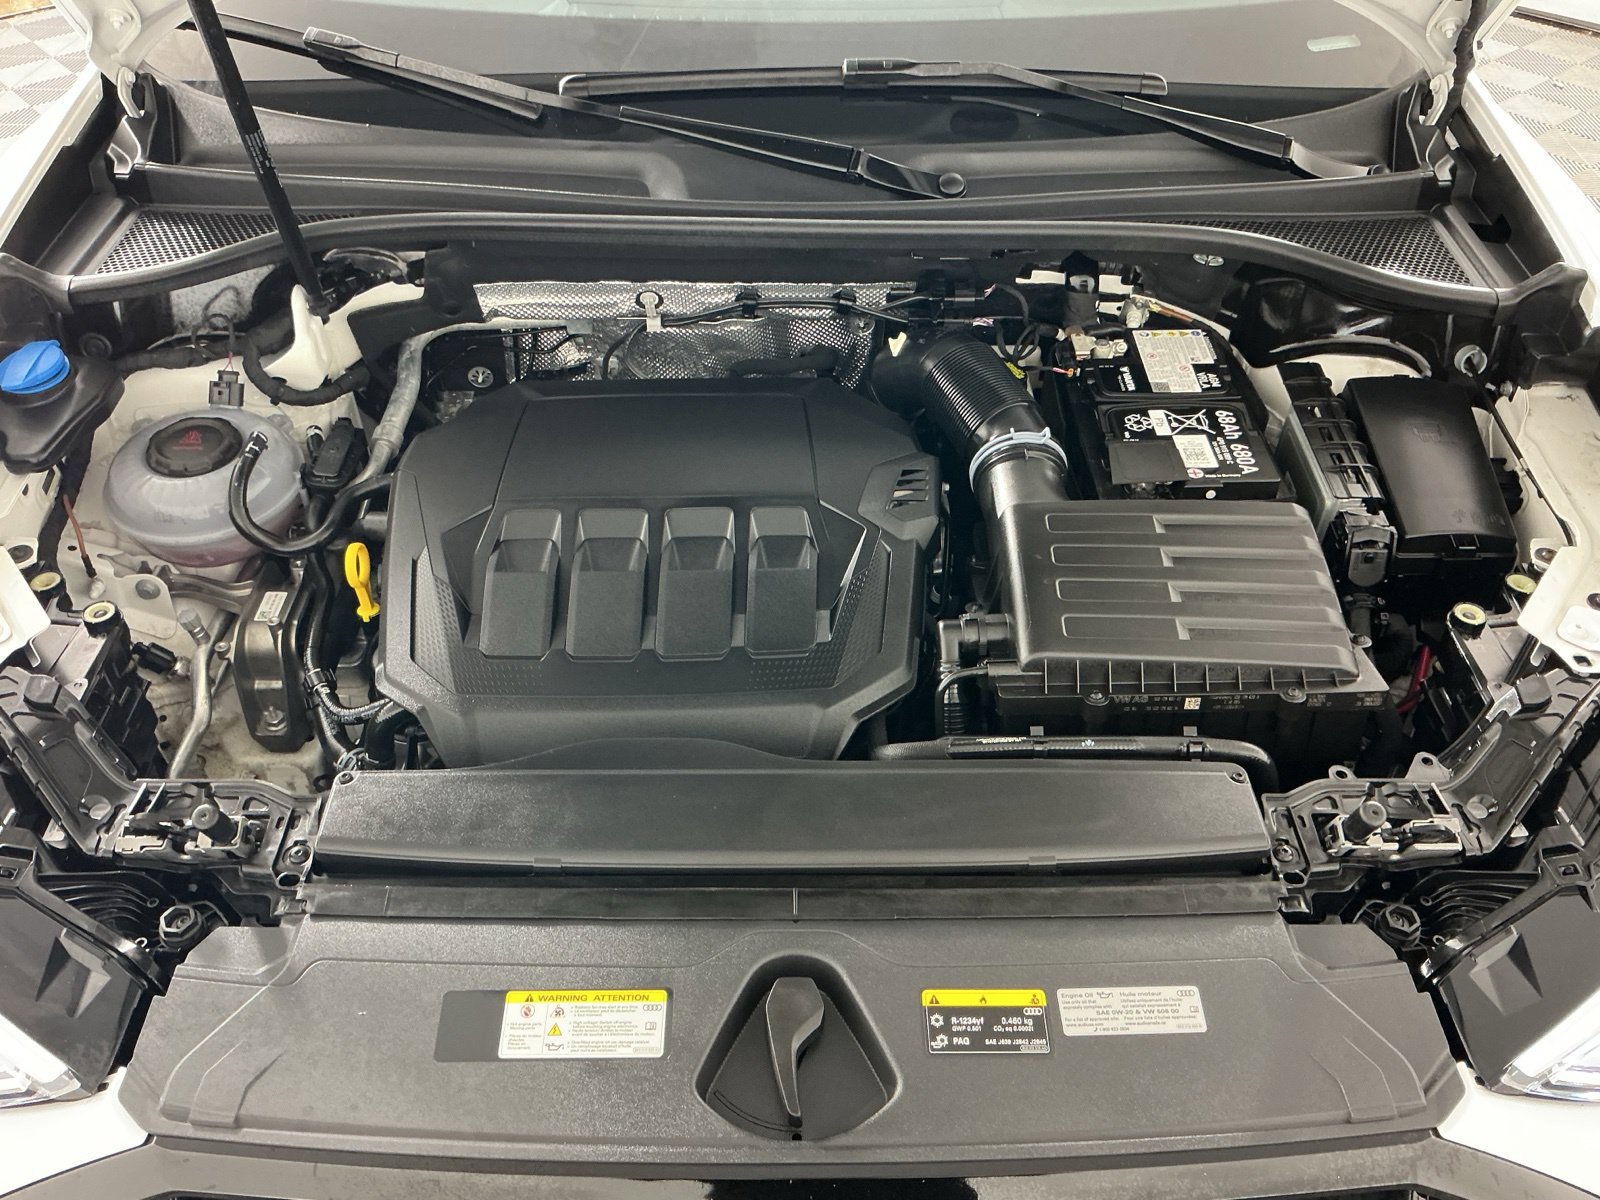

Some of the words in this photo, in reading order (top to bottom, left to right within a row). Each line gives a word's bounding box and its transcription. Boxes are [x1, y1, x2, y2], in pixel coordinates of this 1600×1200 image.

[1207, 373, 1222, 388] AGM
[1215, 410, 1243, 440] 68Ah
[1230, 443, 1260, 475] 680A
[538, 994, 588, 1002] WARNING
[593, 994, 650, 1002] ATTENTION
[951, 1016, 984, 1026] R-1234yf
[1023, 1016, 1033, 1026] kg
[953, 1036, 970, 1046] PAG
